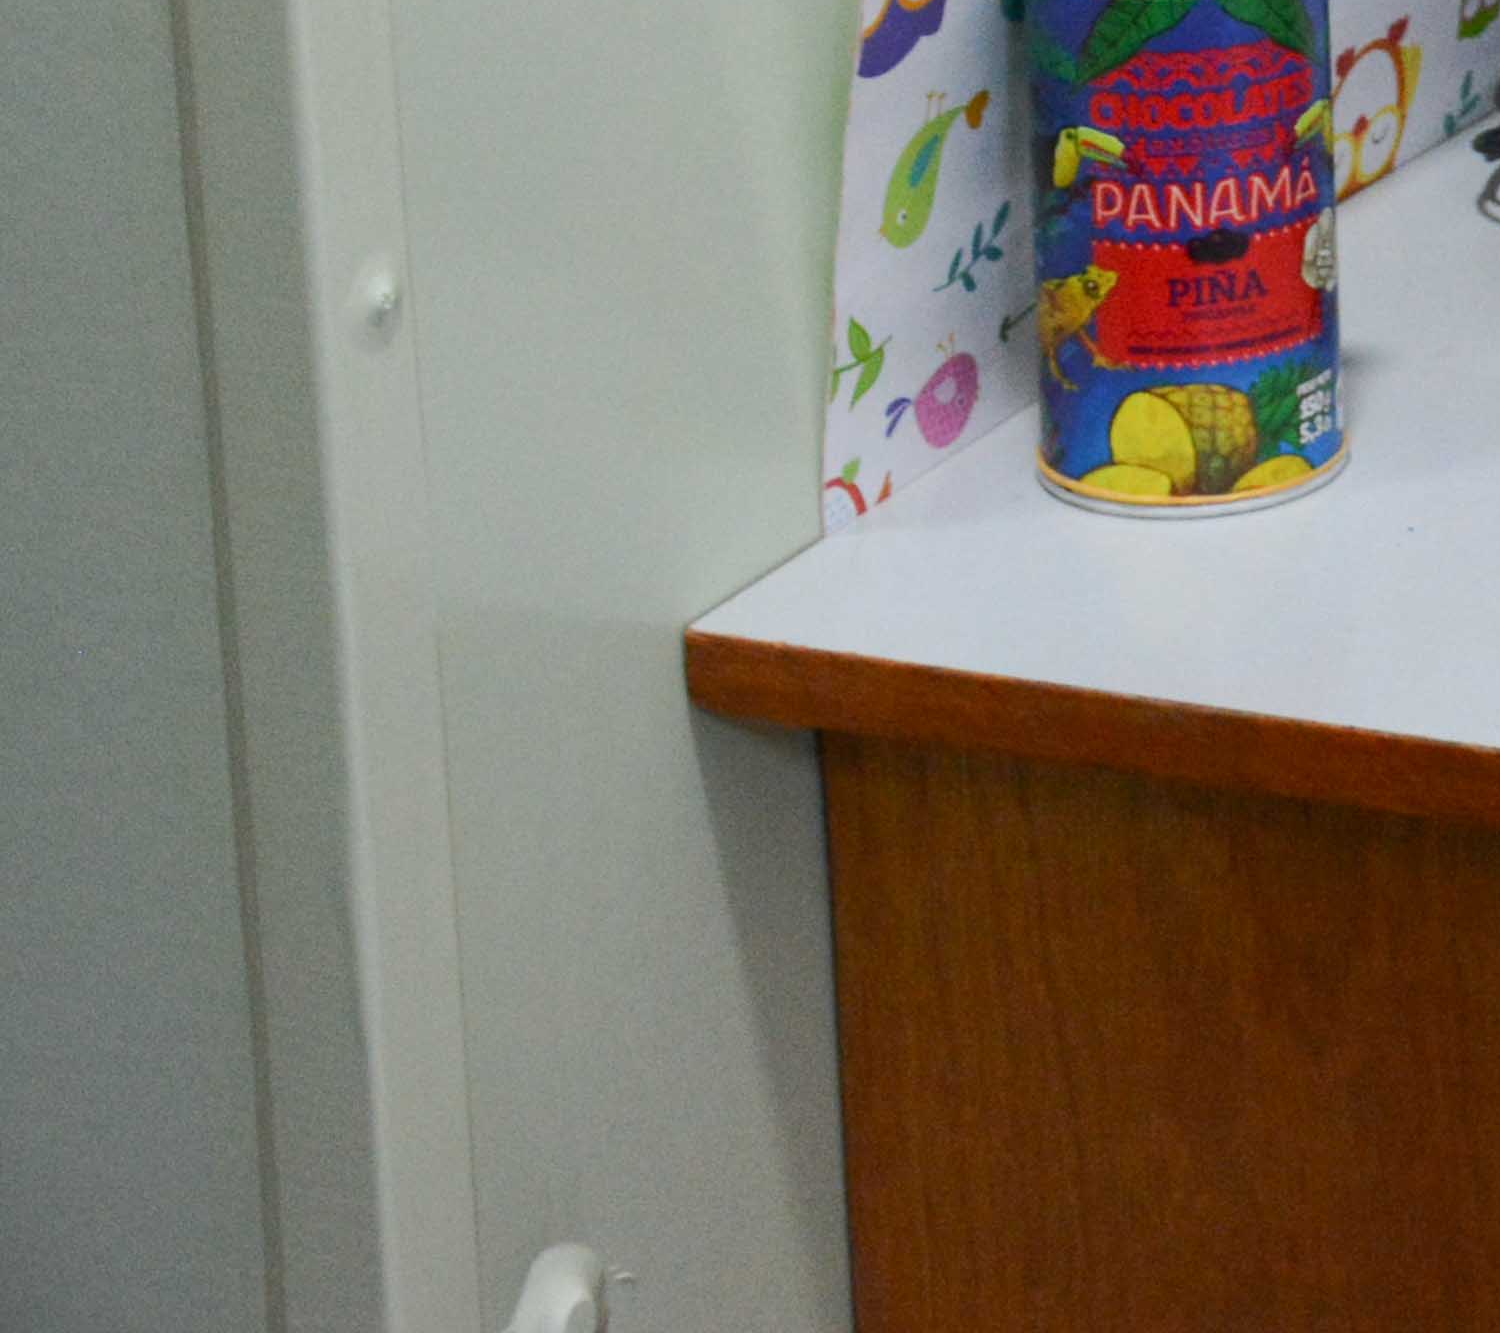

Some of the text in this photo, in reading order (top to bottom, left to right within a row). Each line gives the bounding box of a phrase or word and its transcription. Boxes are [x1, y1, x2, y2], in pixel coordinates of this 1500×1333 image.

[1090, 66, 1313, 130] CHOCOLATES
[1093, 157, 1317, 229] PANAMÁ
[1168, 269, 1268, 308] PIÑA
